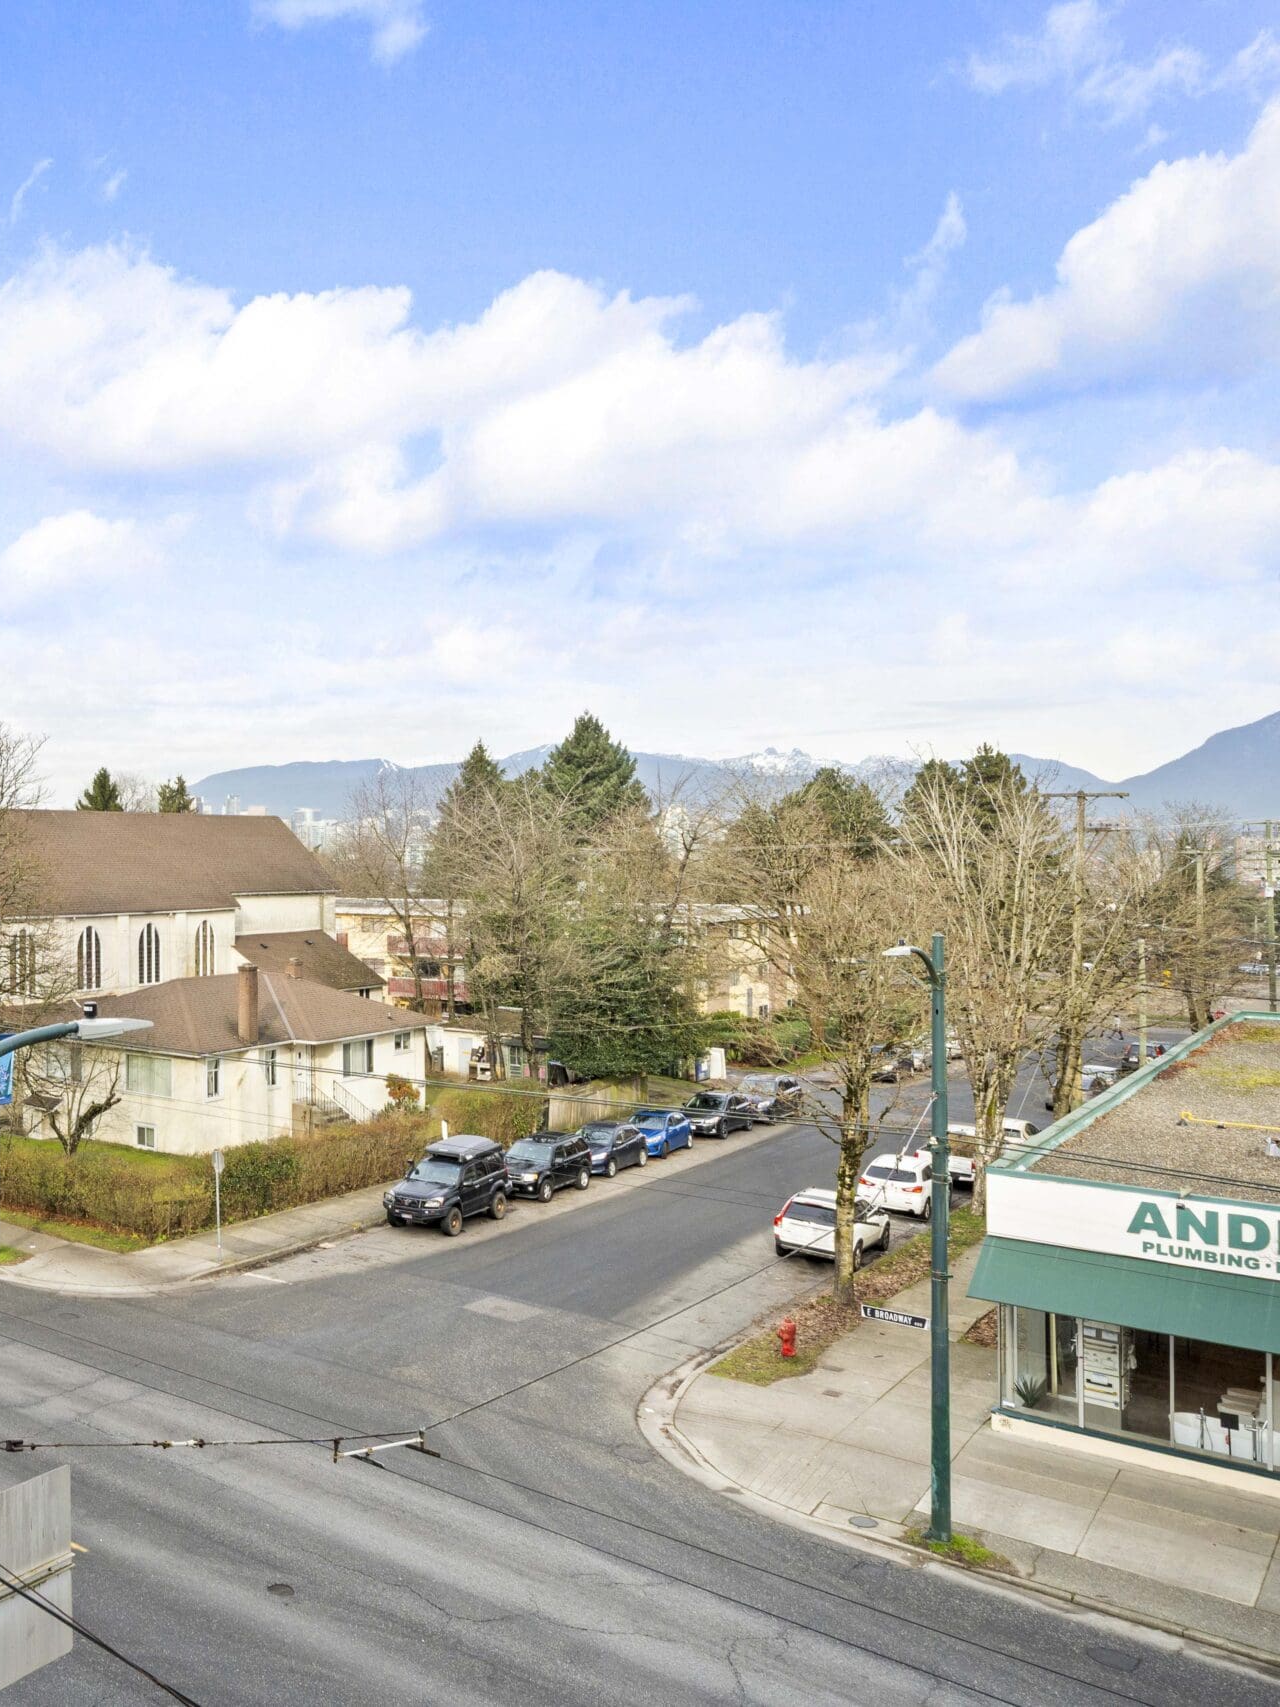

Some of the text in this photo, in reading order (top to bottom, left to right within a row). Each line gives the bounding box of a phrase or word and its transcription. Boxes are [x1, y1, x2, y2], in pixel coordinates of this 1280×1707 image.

[1126, 1201, 1280, 1256] AND
[1142, 1241, 1260, 1270] PLUMBING
[867, 1308, 872, 1316] E
[874, 1310, 913, 1325] BROADWAY
